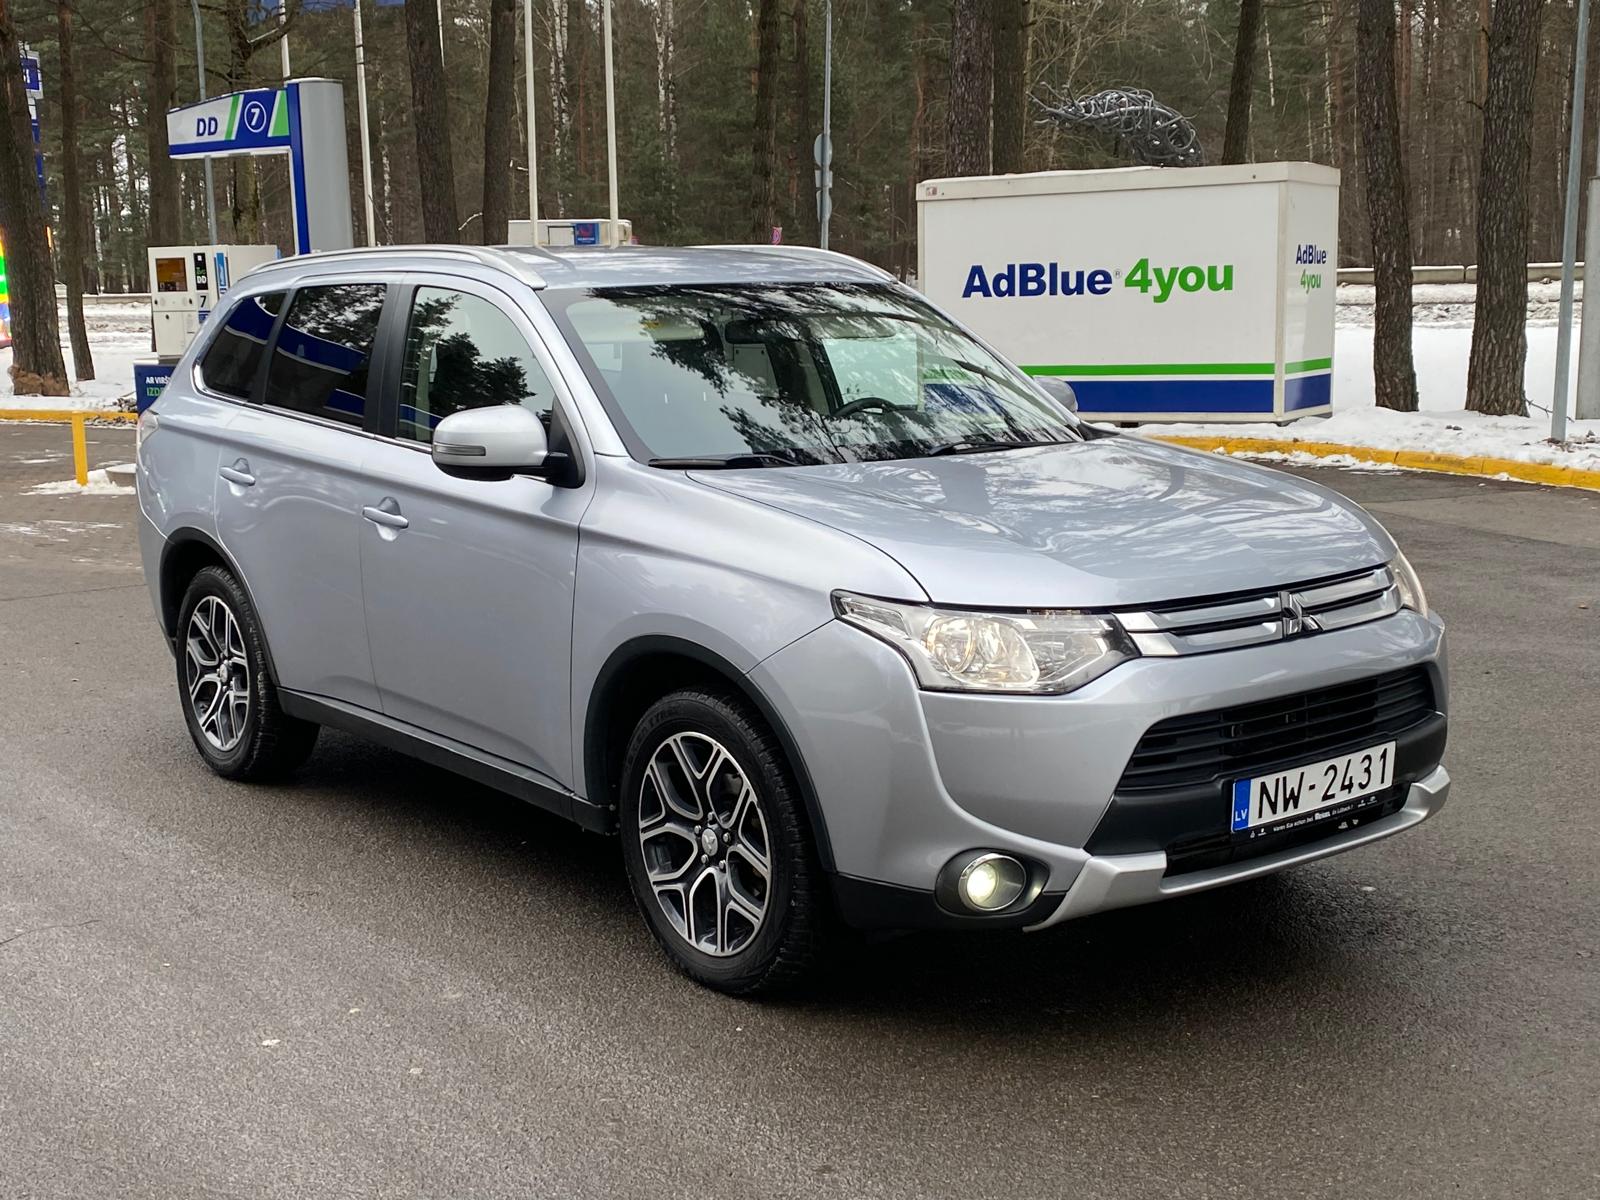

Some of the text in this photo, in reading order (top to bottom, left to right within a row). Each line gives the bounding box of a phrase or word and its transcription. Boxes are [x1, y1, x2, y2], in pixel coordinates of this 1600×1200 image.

[196, 116, 218, 137] DD
[251, 107, 260, 126] 7
[1125, 258, 1234, 303] 4you
[1300, 269, 1322, 295] 4you
[200, 295, 207, 308] 7
[1258, 748, 1388, 819] NW-2431
[1235, 808, 1248, 822] LV
